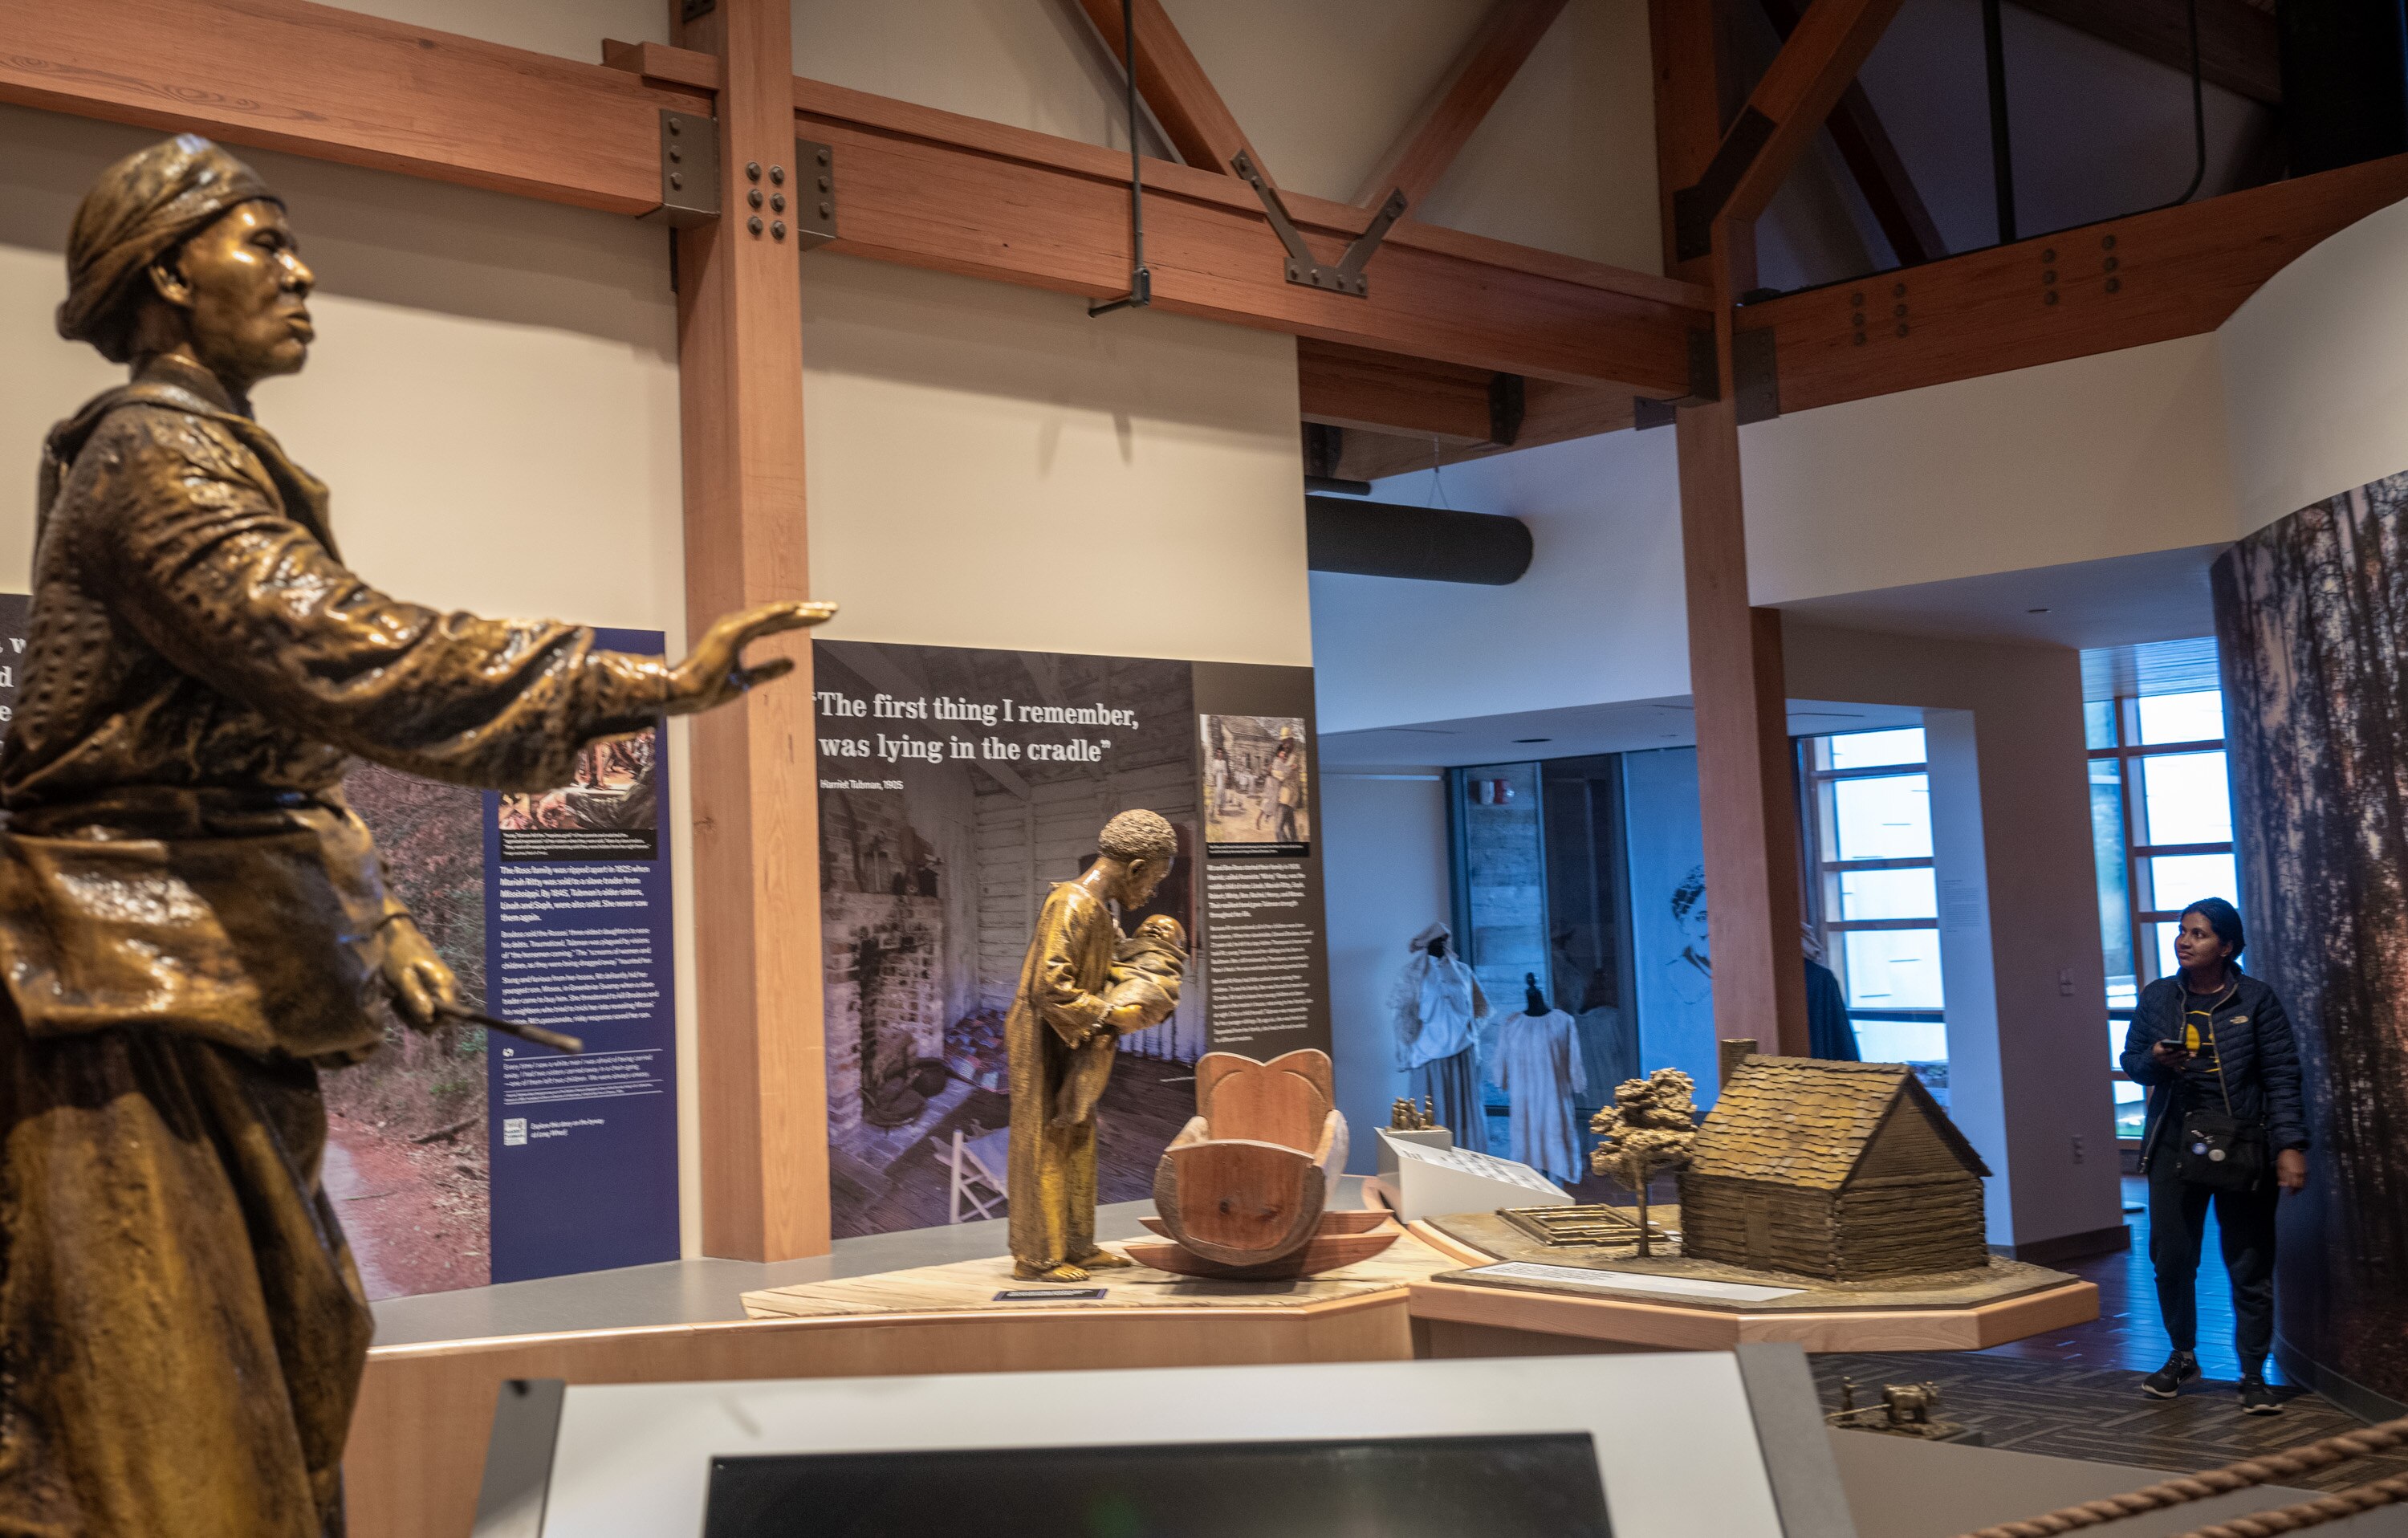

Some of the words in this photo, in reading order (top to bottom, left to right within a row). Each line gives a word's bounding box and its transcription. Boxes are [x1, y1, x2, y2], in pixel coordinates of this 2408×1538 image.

[872, 694, 929, 720] first
[933, 696, 999, 726] thing
[1003, 698, 1015, 722] I
[1018, 702, 1139, 730] remember,
[818, 738, 871, 758] was
[877, 733, 944, 763] lying
[949, 735, 977, 759] in
[981, 736, 1021, 760] the
[1027, 738, 1112, 763] cradle”
[820, 779, 850, 789] Harriet
[849, 779, 884, 791] Tubman,
[883, 779, 904, 790] 1905
